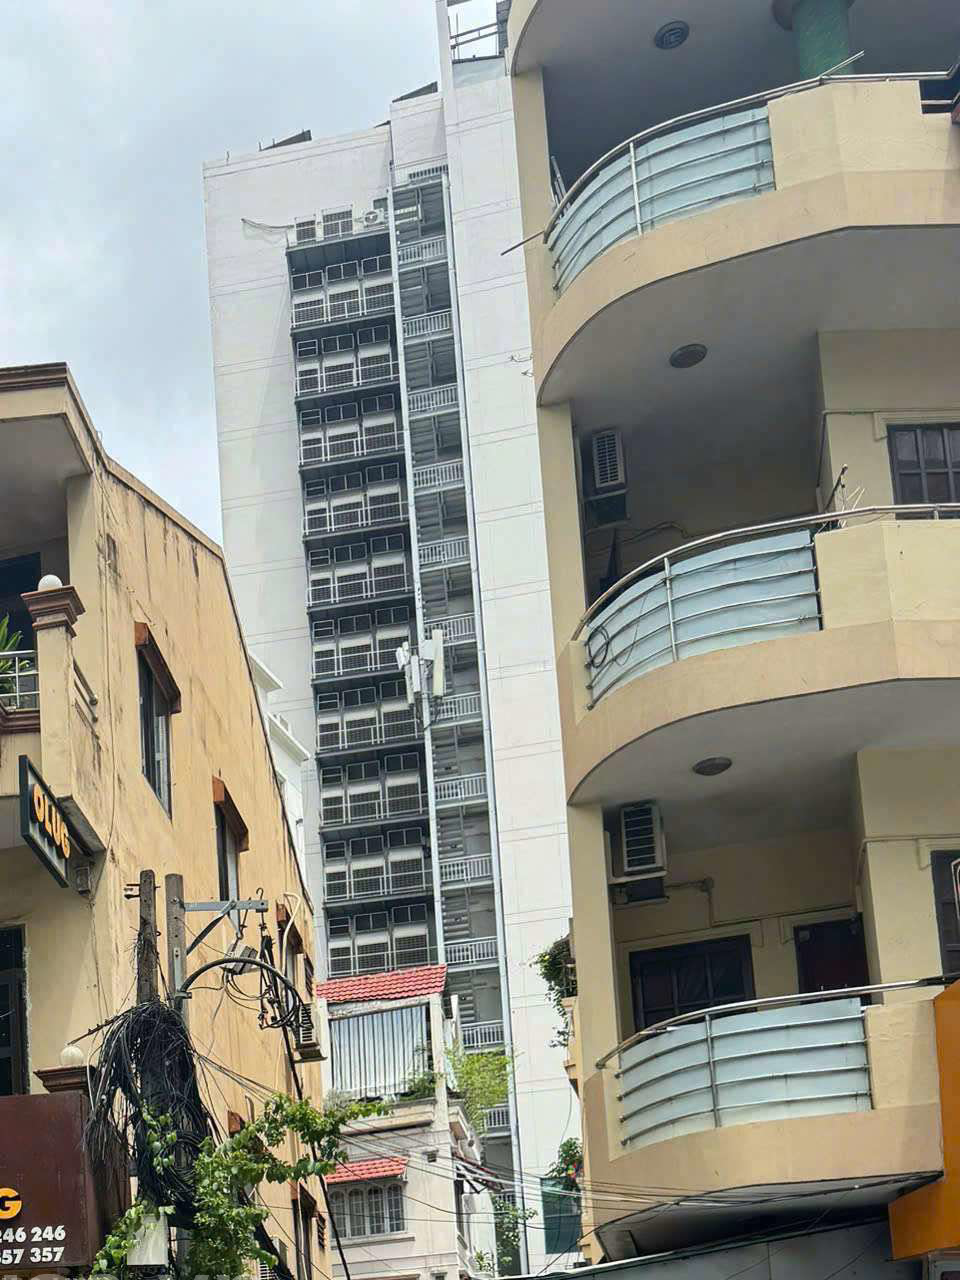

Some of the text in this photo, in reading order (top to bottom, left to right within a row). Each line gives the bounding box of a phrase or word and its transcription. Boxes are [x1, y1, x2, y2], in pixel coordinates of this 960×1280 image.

[33, 783, 71, 859] OLUG
[30, 1224, 66, 1243] 246
[29, 1246, 65, 1264] 357
